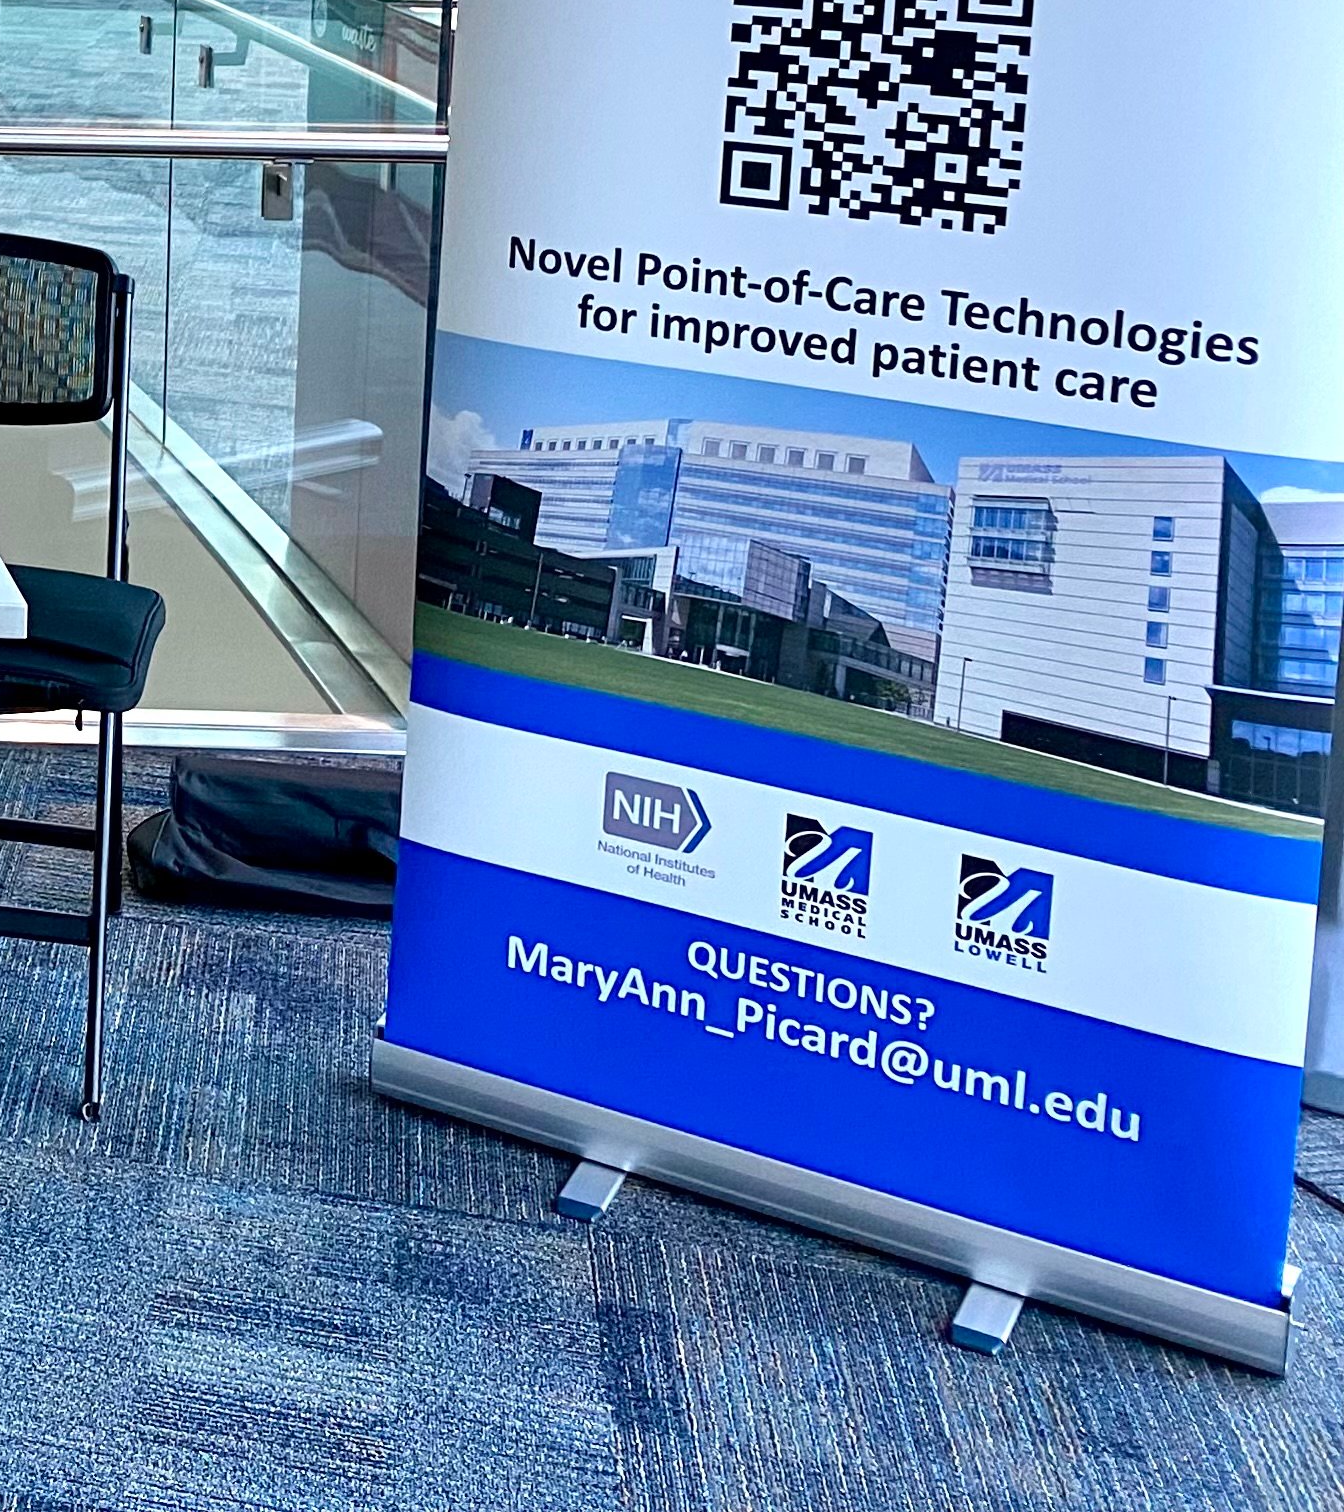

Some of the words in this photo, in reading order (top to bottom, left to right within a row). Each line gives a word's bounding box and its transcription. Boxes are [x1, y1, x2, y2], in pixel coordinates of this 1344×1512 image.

[509, 236, 622, 283] Novel
[638, 253, 925, 322] Point-of-Care
[941, 290, 1259, 365] Technologies
[577, 293, 637, 334] for
[650, 303, 857, 365] improved
[872, 343, 1040, 392] patient
[1055, 369, 1157, 408] care
[613, 789, 680, 834] NIH
[597, 839, 652, 863] National
[652, 853, 715, 878] Institutes
[626, 864, 640, 874] of
[643, 866, 685, 887] Health
[781, 879, 866, 914] UMASS
[781, 897, 866, 926] MEDICAL
[780, 909, 865, 939] SCHOOL
[954, 922, 1047, 959] UMASS
[954, 940, 1046, 973] LOWELL
[688, 941, 935, 1030] QUESTIONS?
[508, 935, 1139, 1142] MaryAnn_Picard@uml.edu
